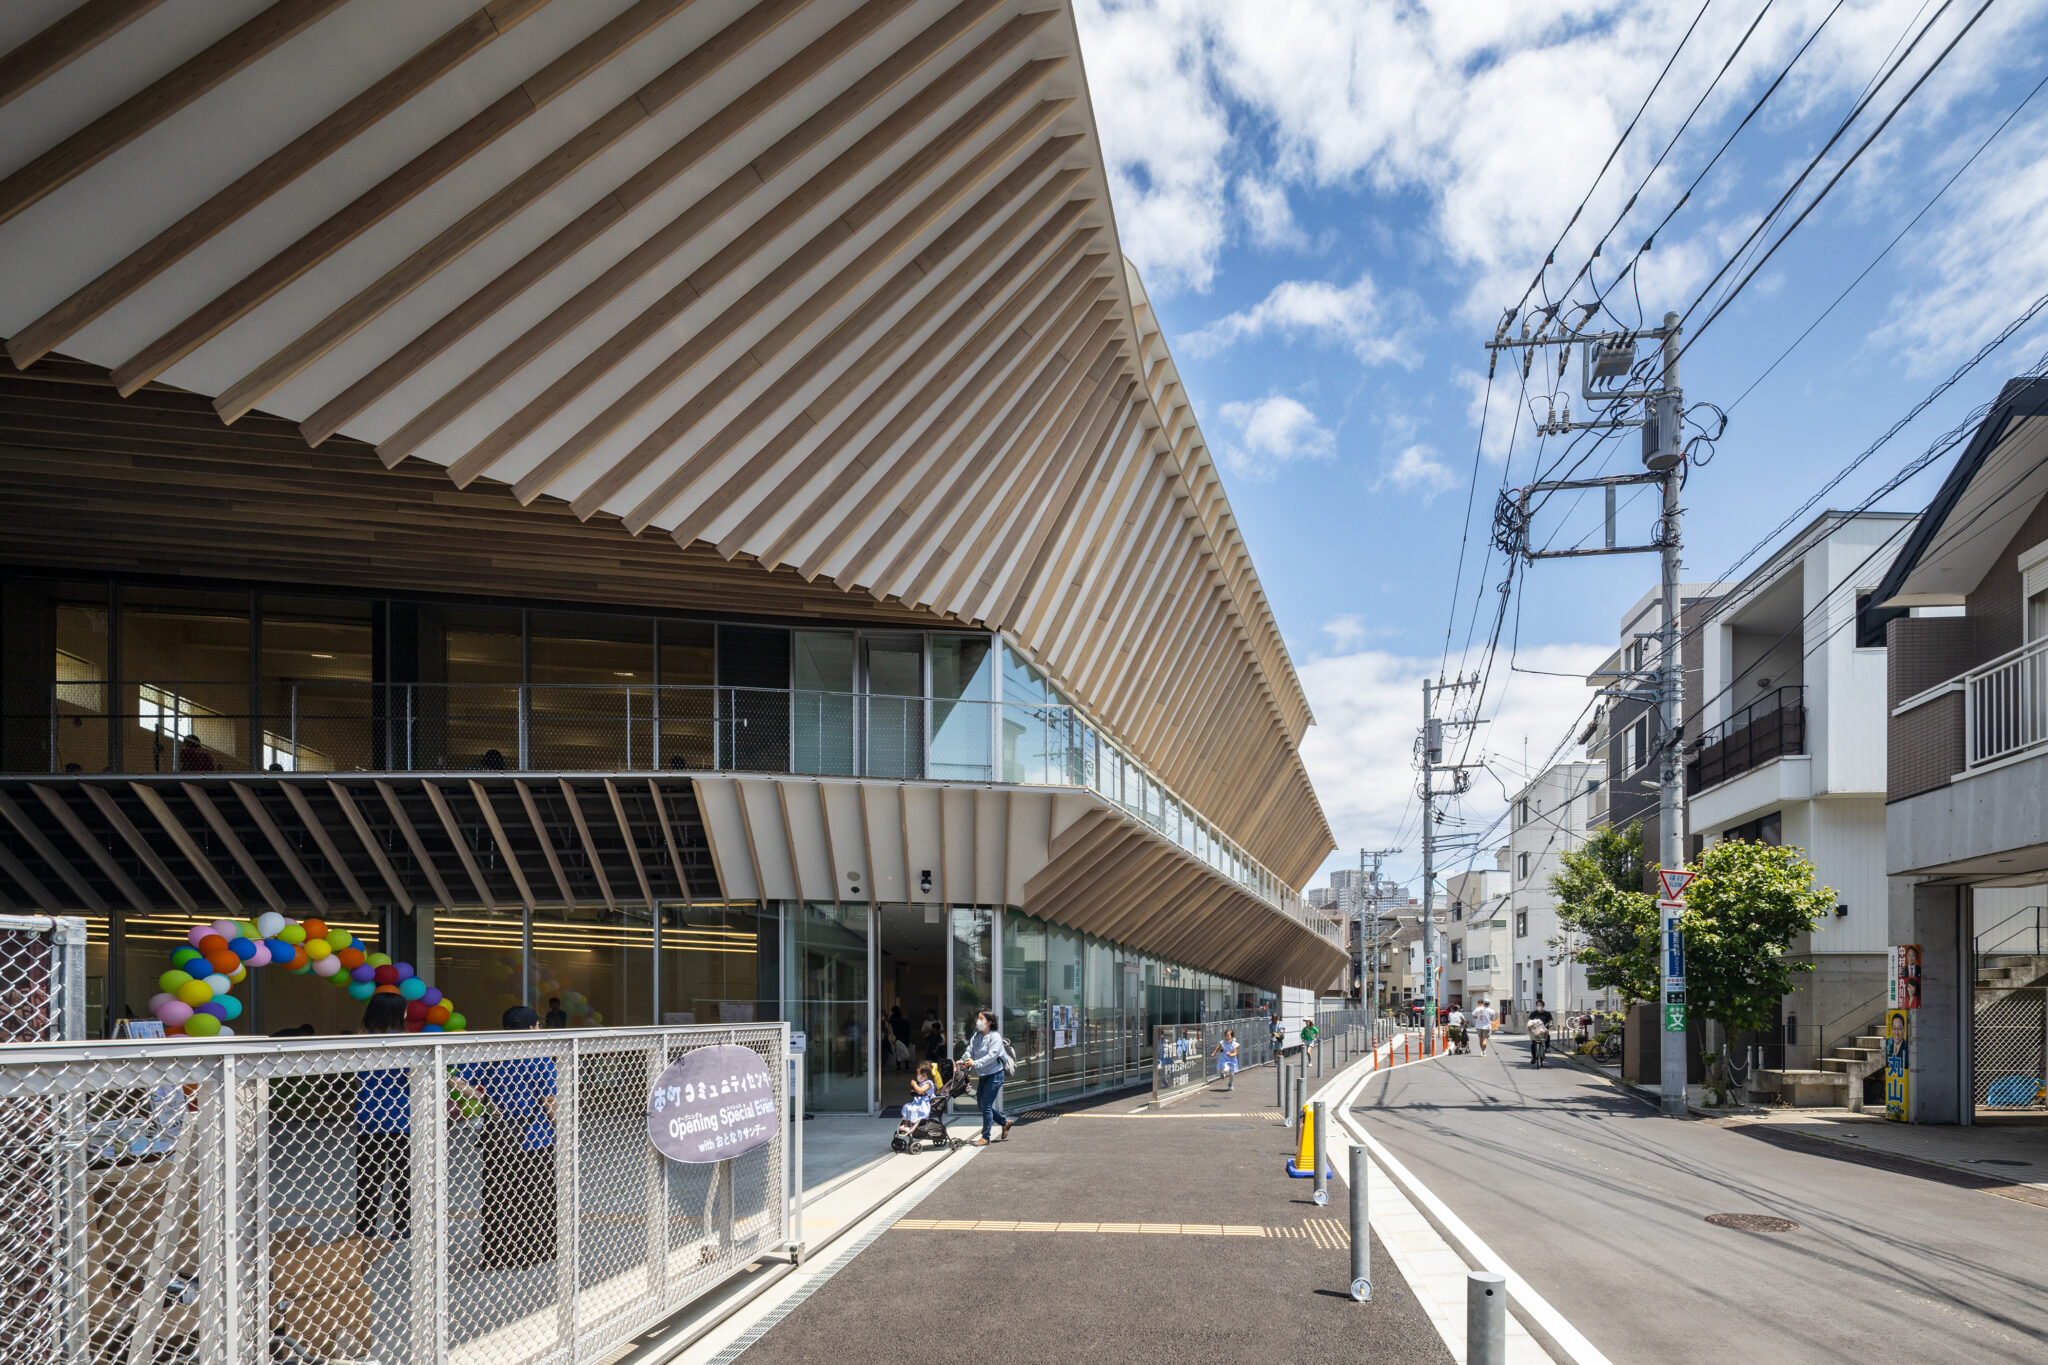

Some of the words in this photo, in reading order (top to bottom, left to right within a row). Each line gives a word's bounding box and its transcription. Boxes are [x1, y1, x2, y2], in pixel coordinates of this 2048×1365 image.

[1668, 1012, 1684, 1029] 文
[1887, 1053, 1904, 1103] 丸山
[669, 1113, 719, 1141] Opening
[720, 1101, 756, 1128] Special
[754, 1098, 776, 1116] Event
[698, 1138, 715, 1153] with
[715, 1123, 767, 1148] おとなりサンデー
